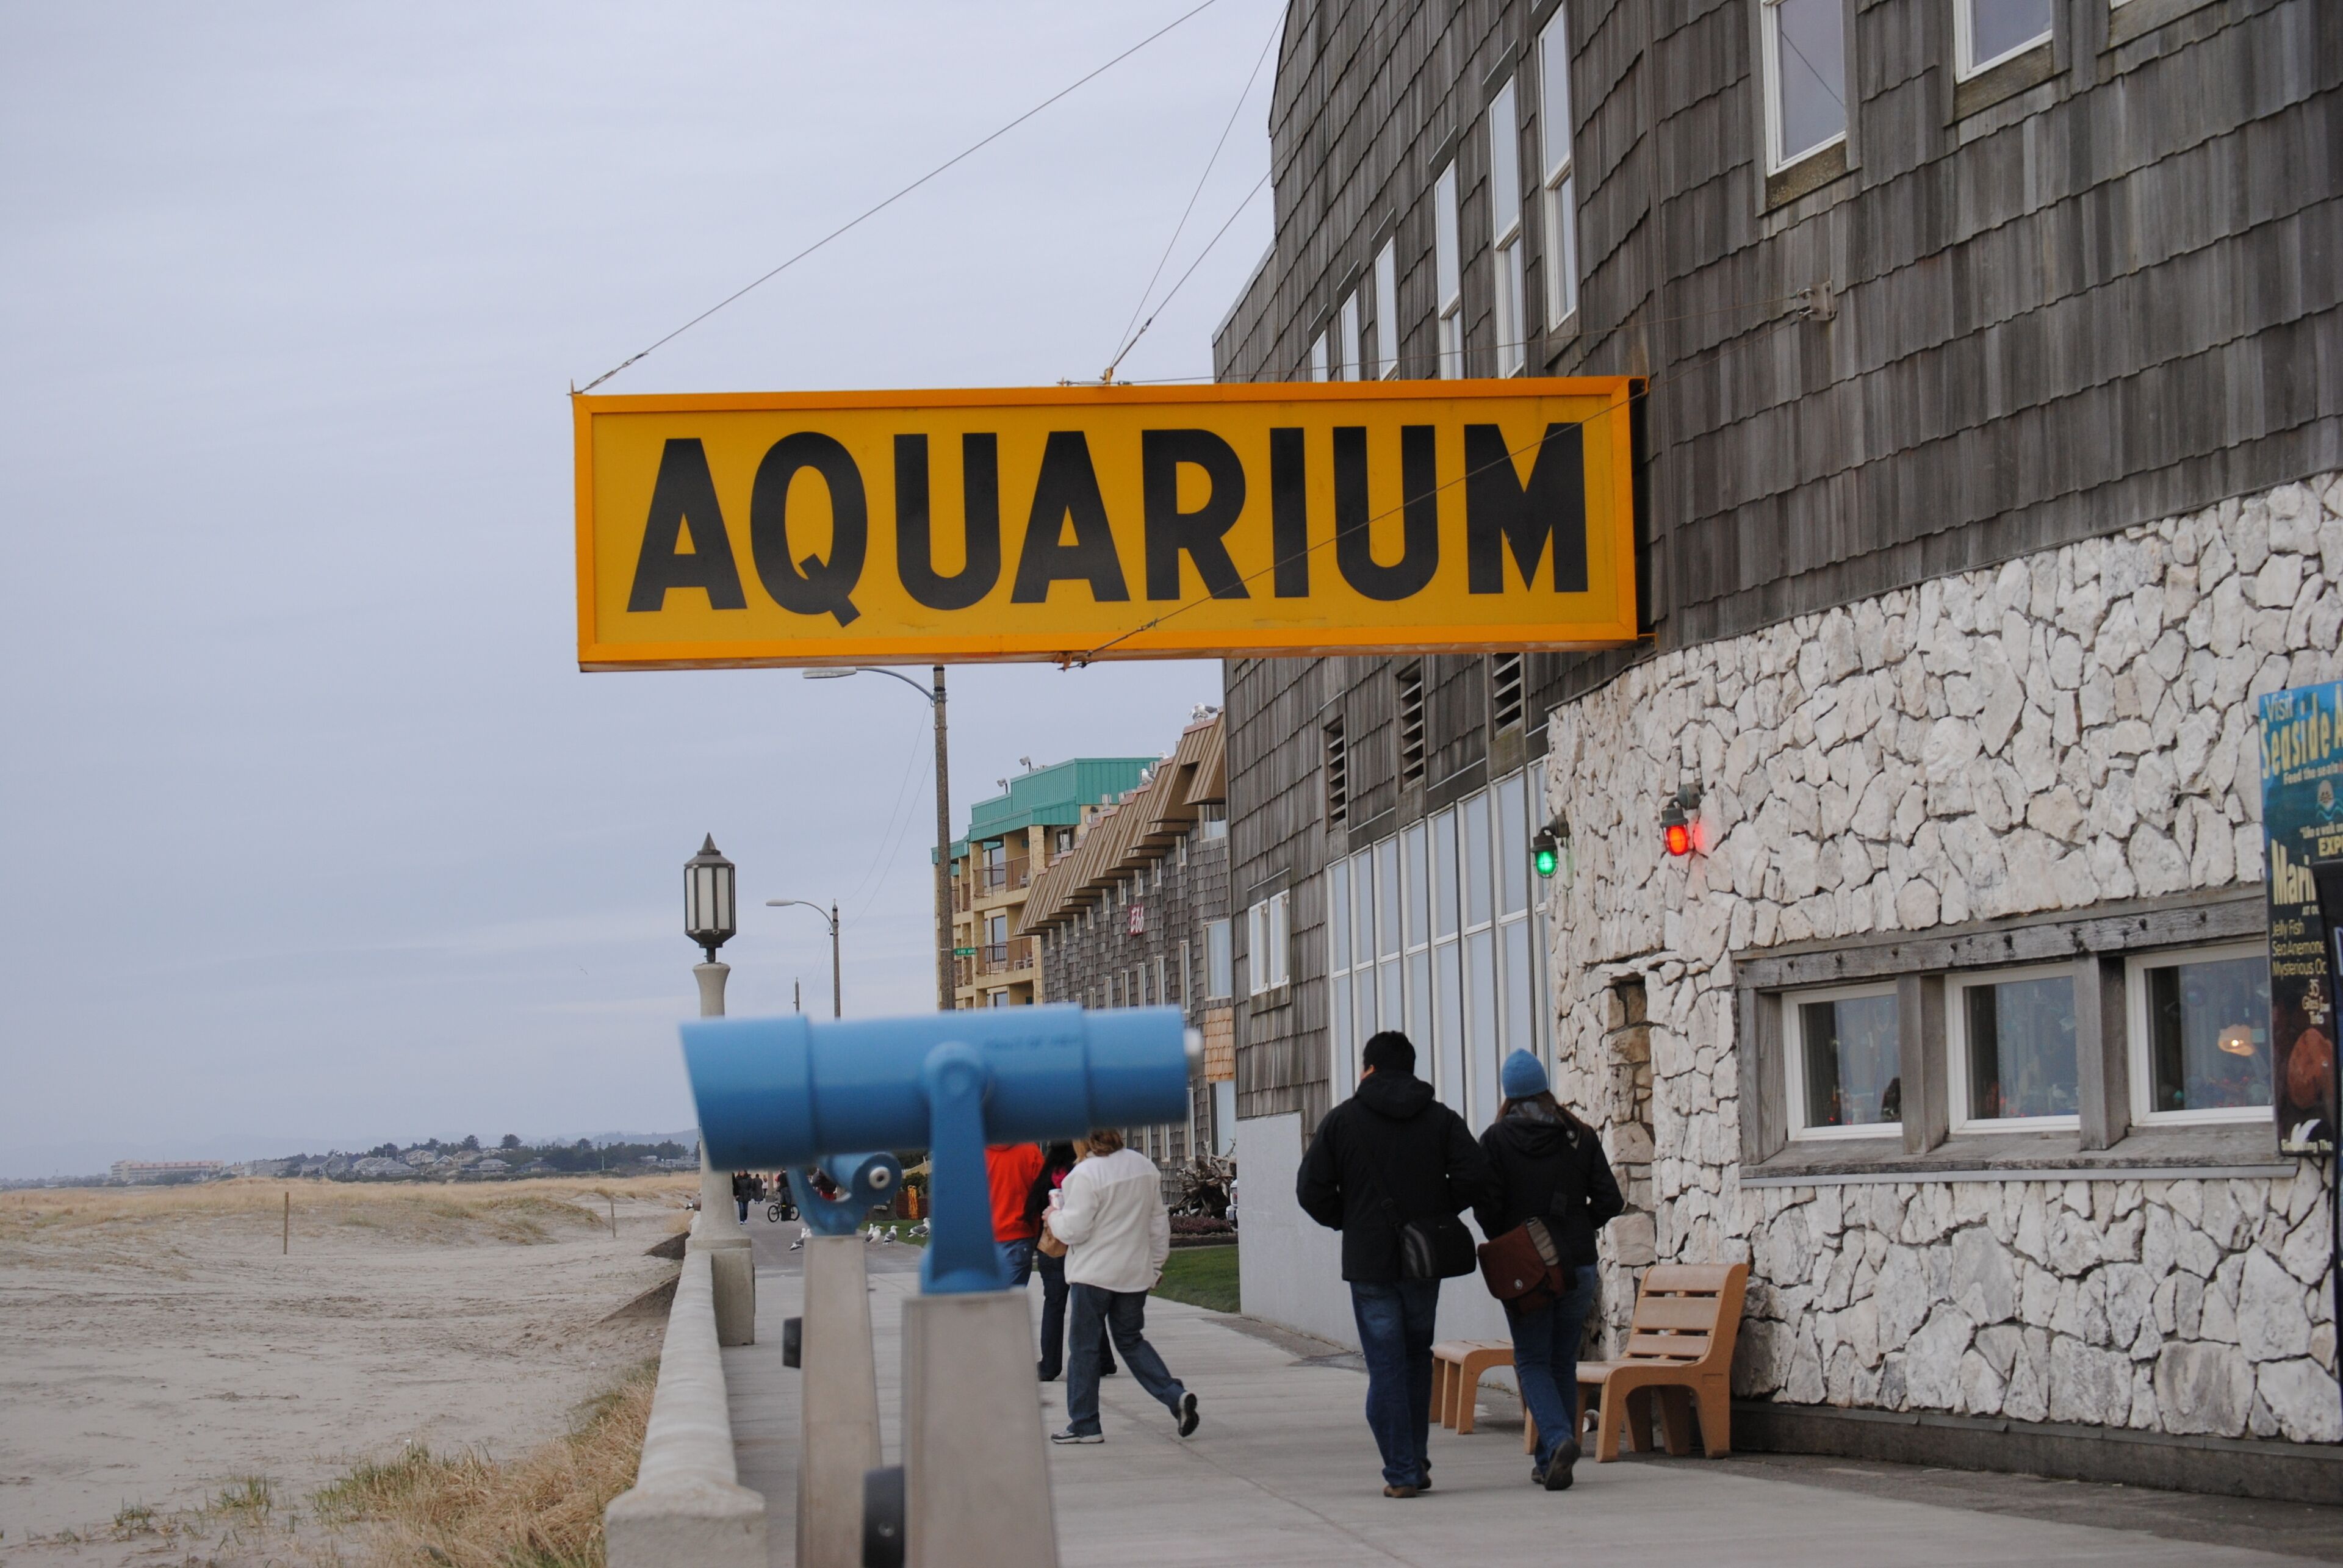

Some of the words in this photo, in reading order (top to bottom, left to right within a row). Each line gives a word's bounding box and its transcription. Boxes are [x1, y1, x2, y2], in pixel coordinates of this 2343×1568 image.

[627, 422, 1589, 628] AQUARIUM
[2264, 691, 2293, 722] Visit
[2260, 693, 2330, 779] Seaside
[2318, 835, 2343, 857] EXP
[2272, 919, 2287, 940] Jelly
[2288, 918, 2305, 935] Fish
[2272, 941, 2287, 957] Sea
[2272, 958, 2314, 980] Mysterious
